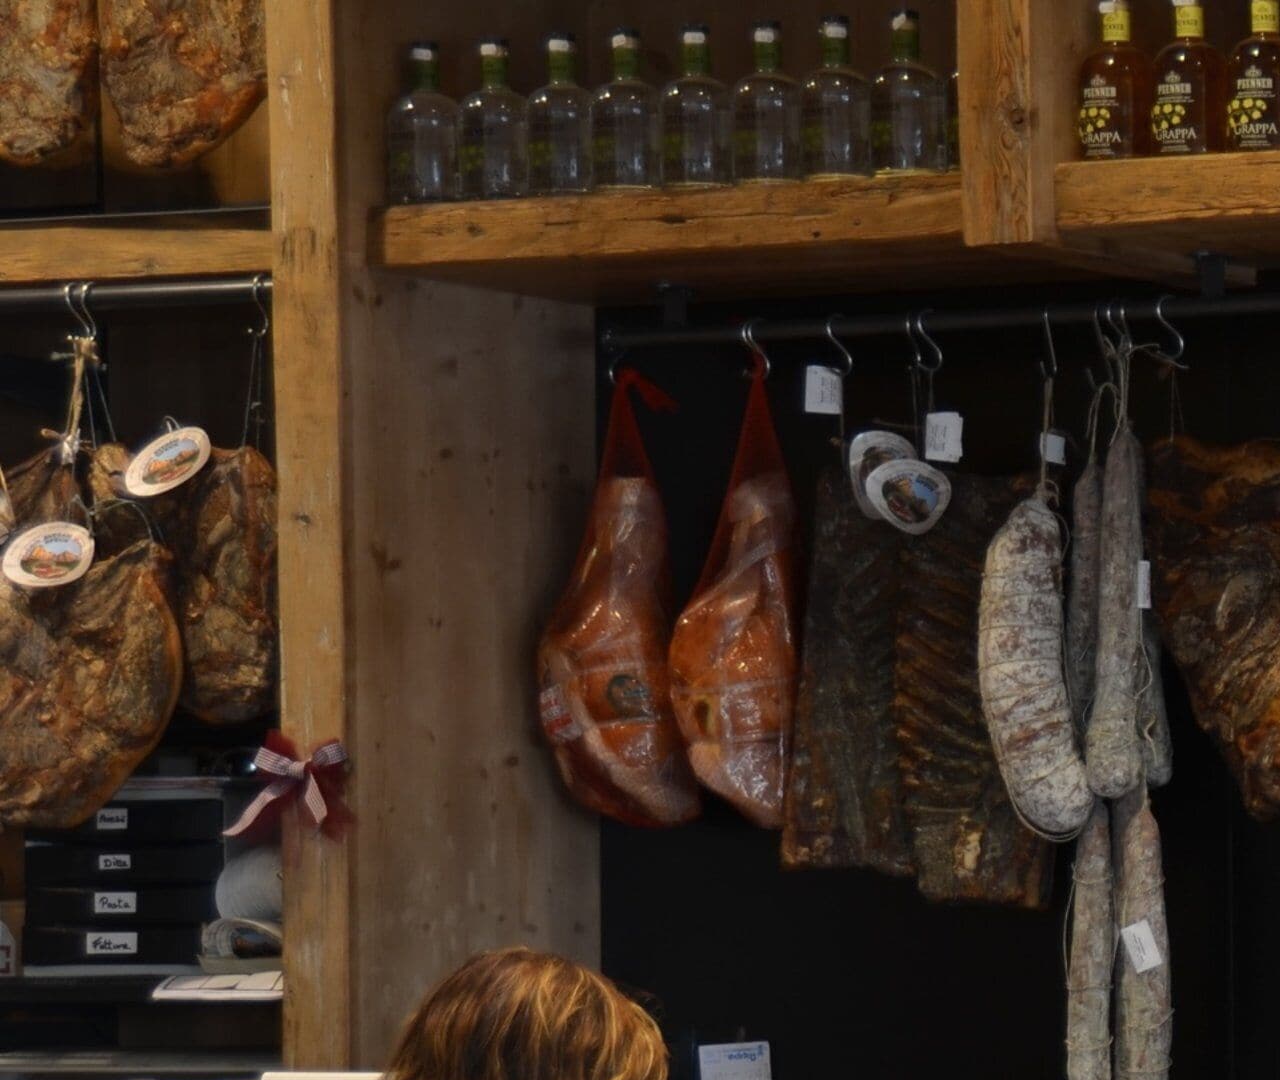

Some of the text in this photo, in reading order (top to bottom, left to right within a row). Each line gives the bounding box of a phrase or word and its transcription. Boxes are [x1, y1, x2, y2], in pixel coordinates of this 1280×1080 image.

[1155, 127, 1197, 142] GRAPPA
[1233, 123, 1278, 136] GRAPPA
[1081, 131, 1122, 145] GRAPPA
